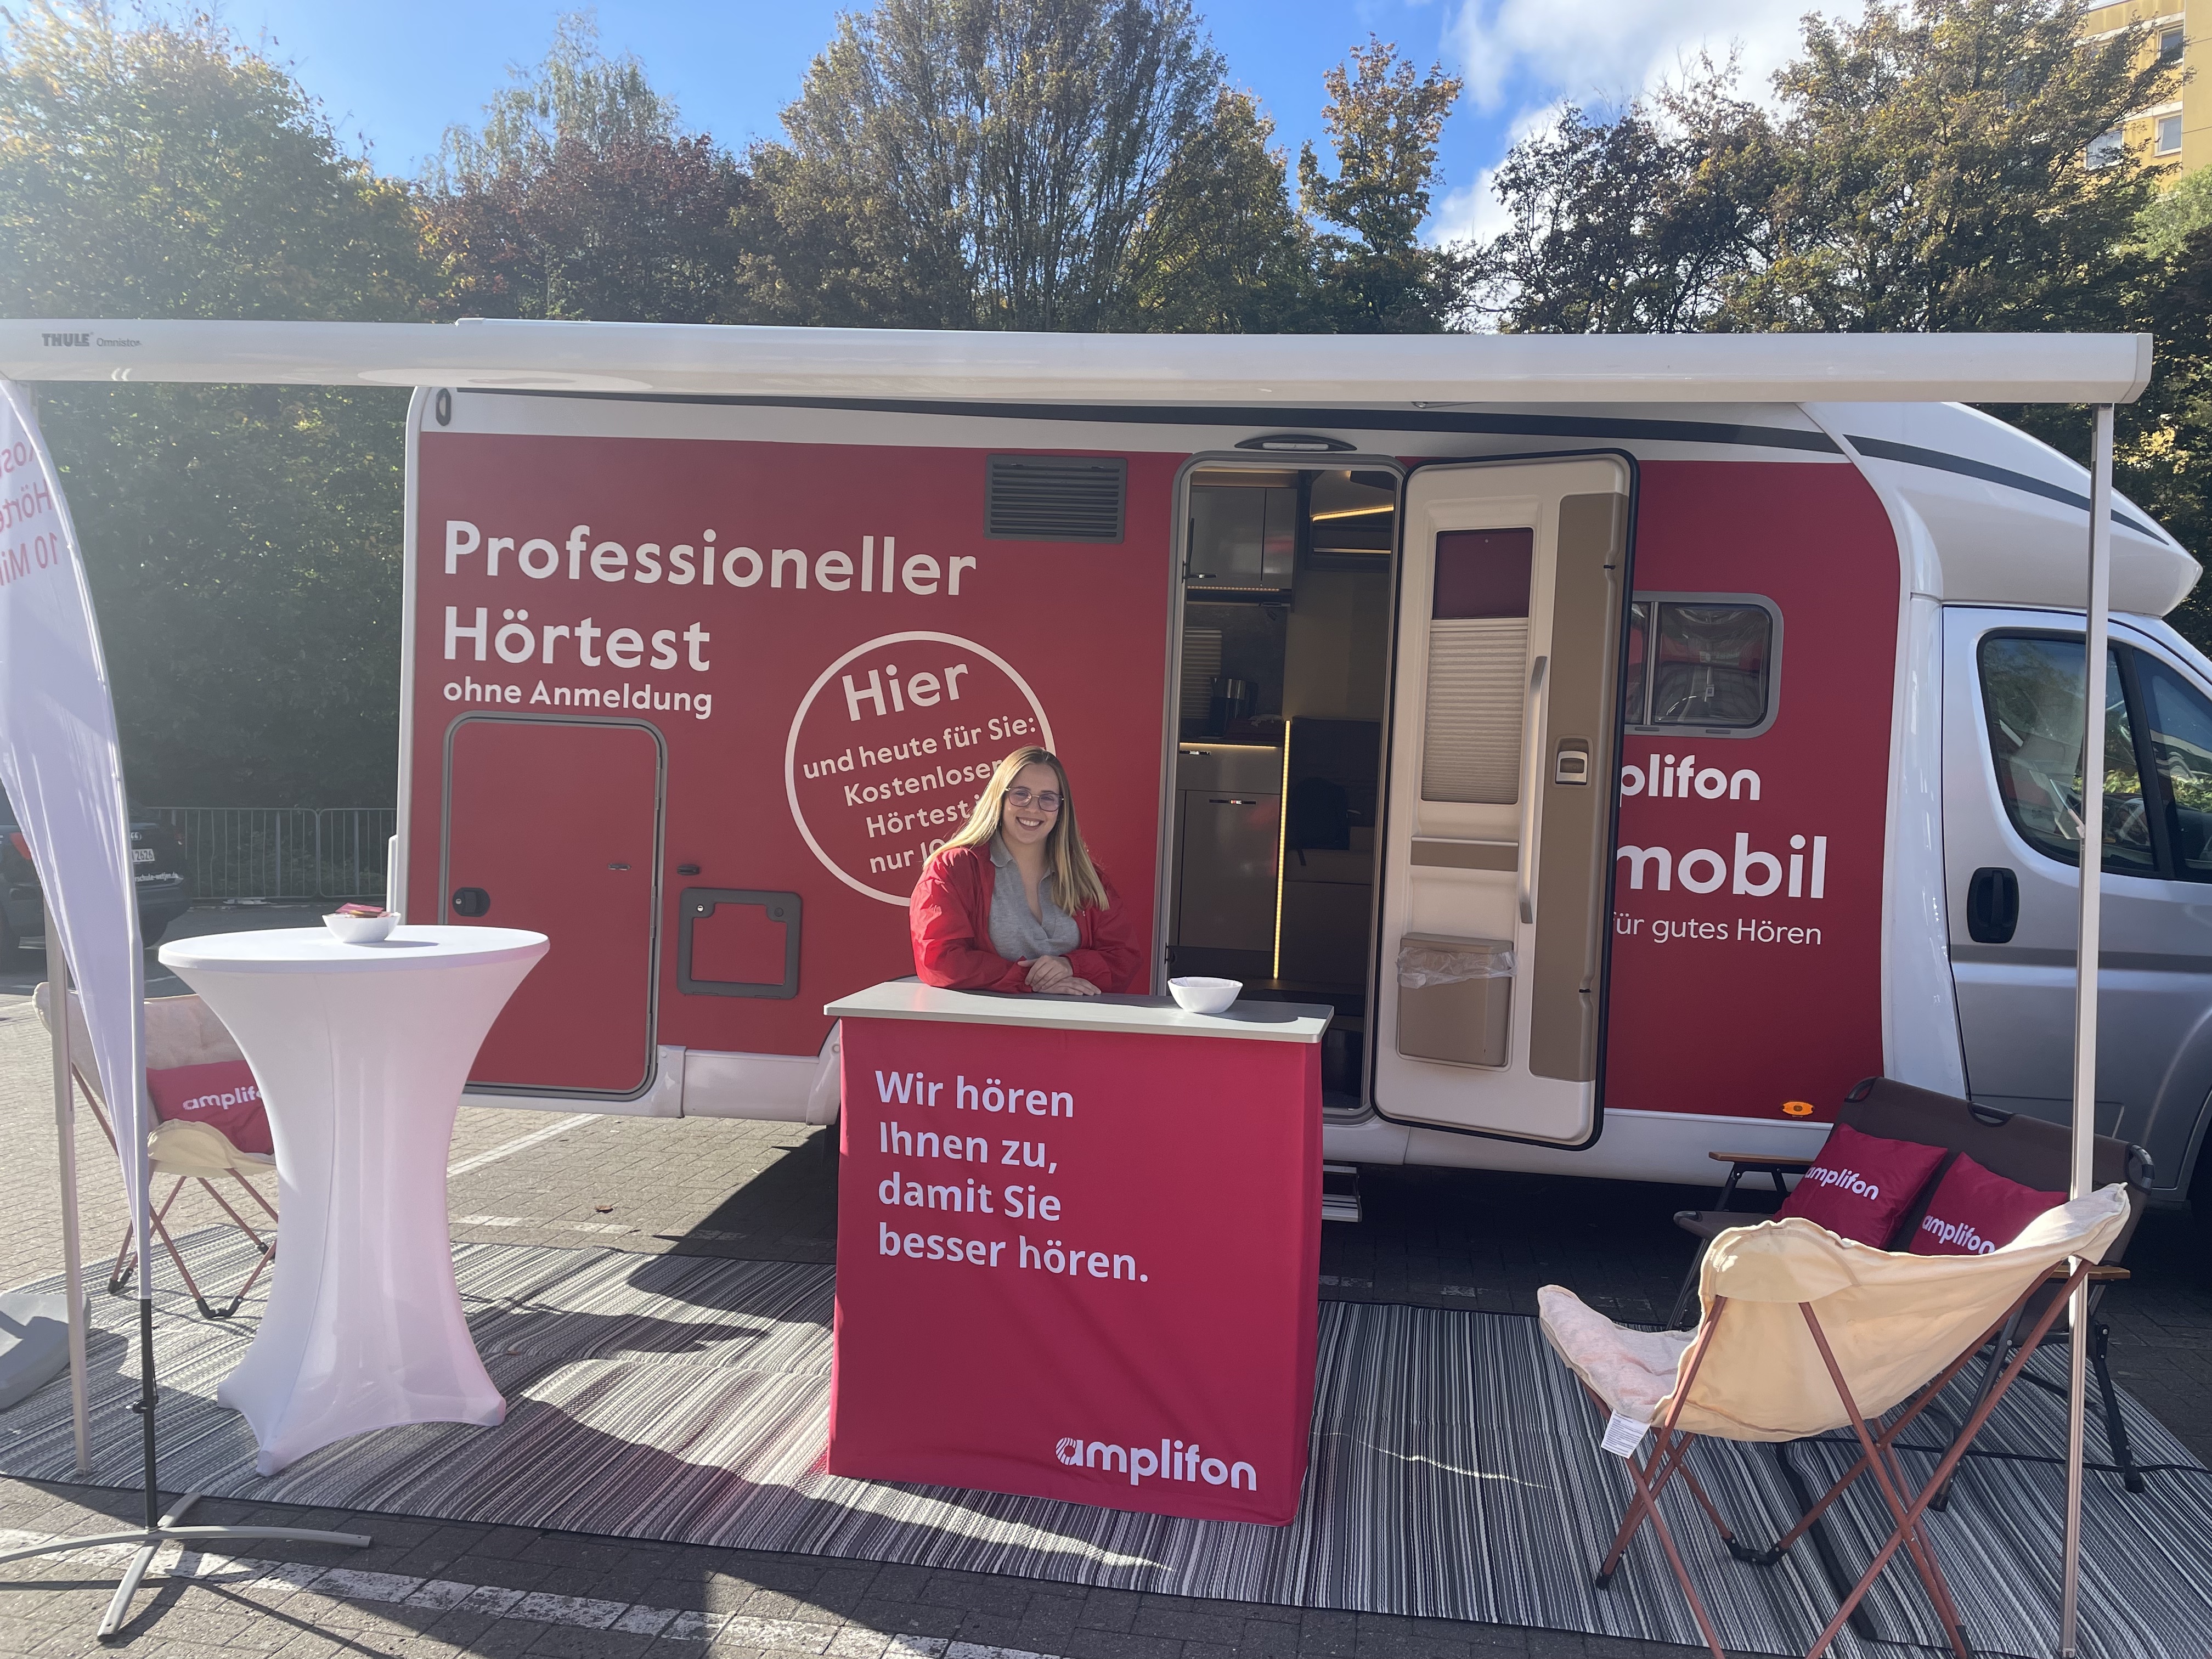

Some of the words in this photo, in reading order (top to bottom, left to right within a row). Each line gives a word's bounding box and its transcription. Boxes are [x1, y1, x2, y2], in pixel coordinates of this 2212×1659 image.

[41, 333, 90, 347] THULE
[445, 521, 977, 597] Professioneller
[444, 606, 710, 672] Hörtest
[443, 676, 522, 704] ohne
[529, 680, 712, 720] Anmeldung
[842, 663, 969, 721] Hier
[803, 748, 854, 779] und
[859, 737, 938, 768] heute
[943, 726, 982, 750] für
[988, 715, 1036, 741] Sie:
[844, 759, 1002, 806] Kostenloser
[866, 799, 971, 838] Hörtest
[870, 850, 915, 873] nur
[1616, 832, 1827, 899] mobil
[1613, 911, 1645, 935] ür
[1652, 918, 1728, 943] gutes
[1737, 918, 1821, 945] Hören
[874, 1070, 944, 1107] Wir
[957, 1075, 1074, 1118] hören
[879, 1121, 988, 1163] Ihnen
[1001, 1139, 1058, 1174] zu,
[878, 1171, 994, 1214] damit
[1004, 1185, 1061, 1221] Sie
[1805, 1167, 1879, 1200] amplifon
[879, 1222, 1006, 1267] besser
[1019, 1235, 1149, 1283] hören.
[1922, 1215, 1995, 1255] amplifon
[1056, 1436, 1257, 1491] amplifon
